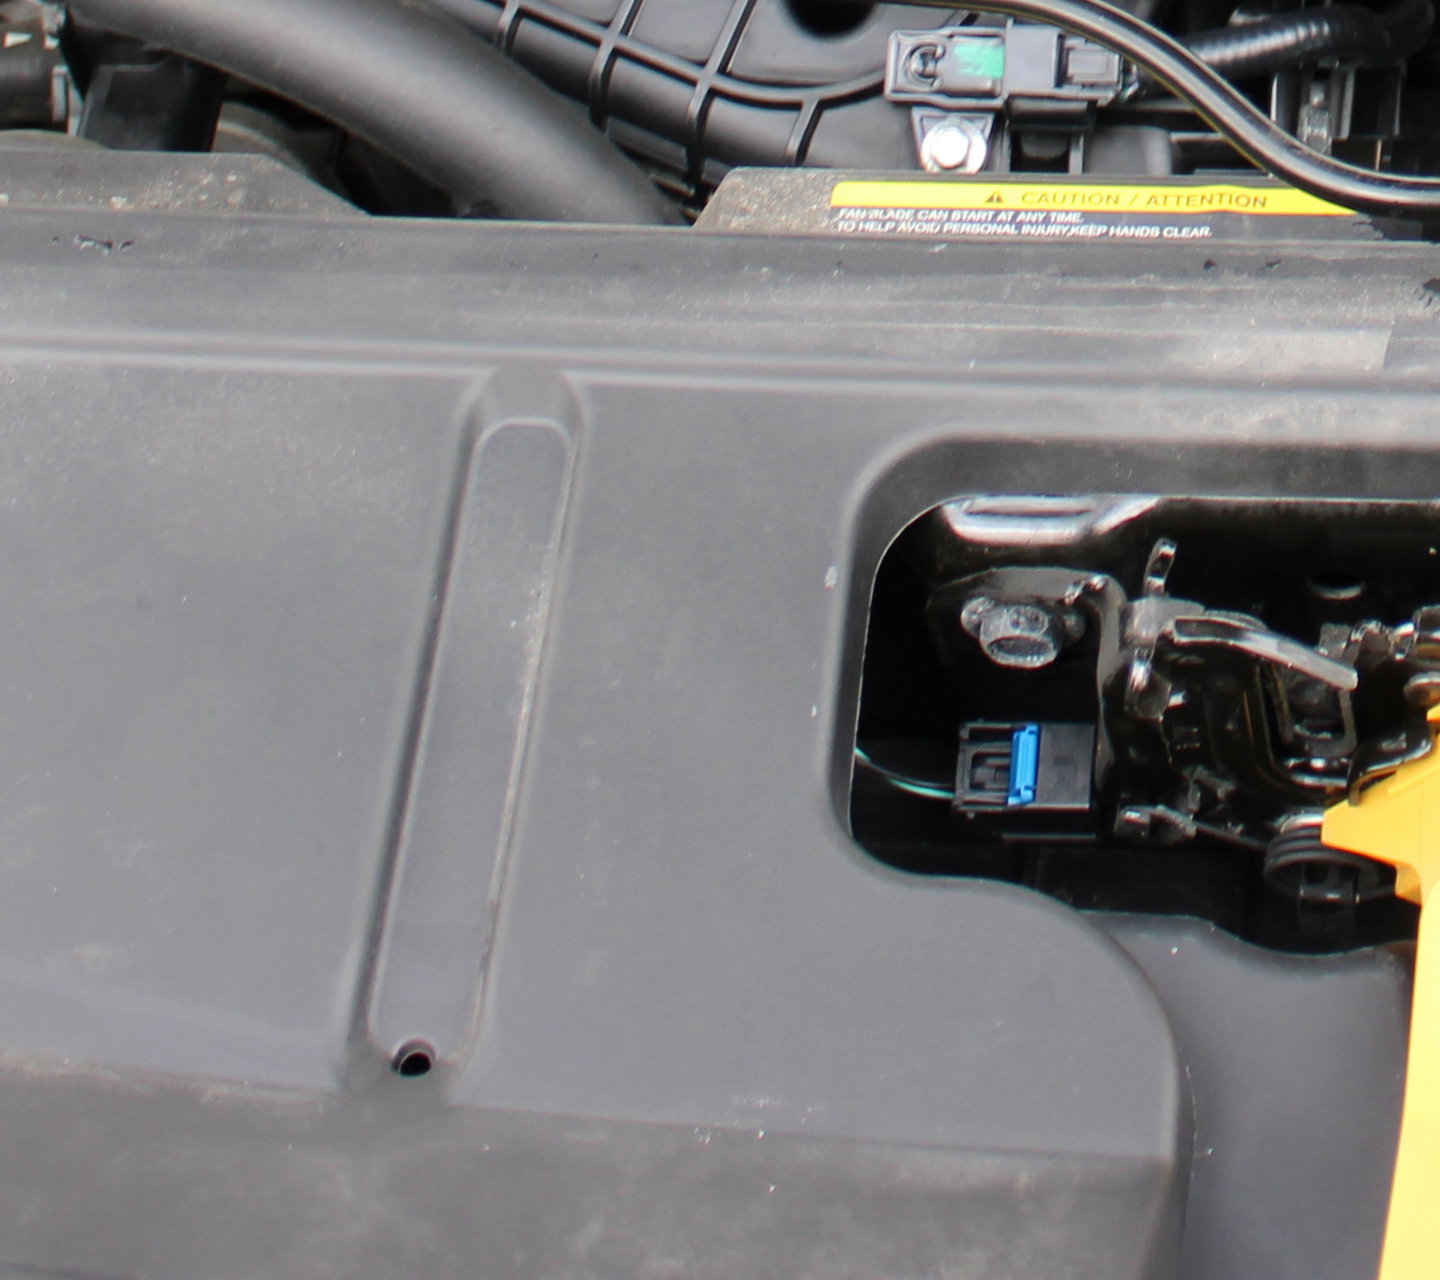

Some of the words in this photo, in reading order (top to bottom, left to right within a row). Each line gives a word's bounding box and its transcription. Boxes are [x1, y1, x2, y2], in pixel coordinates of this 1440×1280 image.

[1021, 191, 1120, 206] CAUTION
[1146, 191, 1268, 209] ATTENTION
[837, 208, 866, 220] FAN
[867, 208, 913, 221] BLADE
[916, 209, 949, 221] CAN
[951, 210, 994, 222] START
[996, 210, 1014, 222] AT
[1016, 211, 1048, 223] ANY
[837, 221, 855, 233] TO
[859, 221, 895, 233] HELP
[897, 222, 941, 234] AVOID
[942, 223, 1018, 236] PERSONAL
[1108, 225, 1160, 238] HANDS
[1162, 226, 1213, 239] CLEAR.
